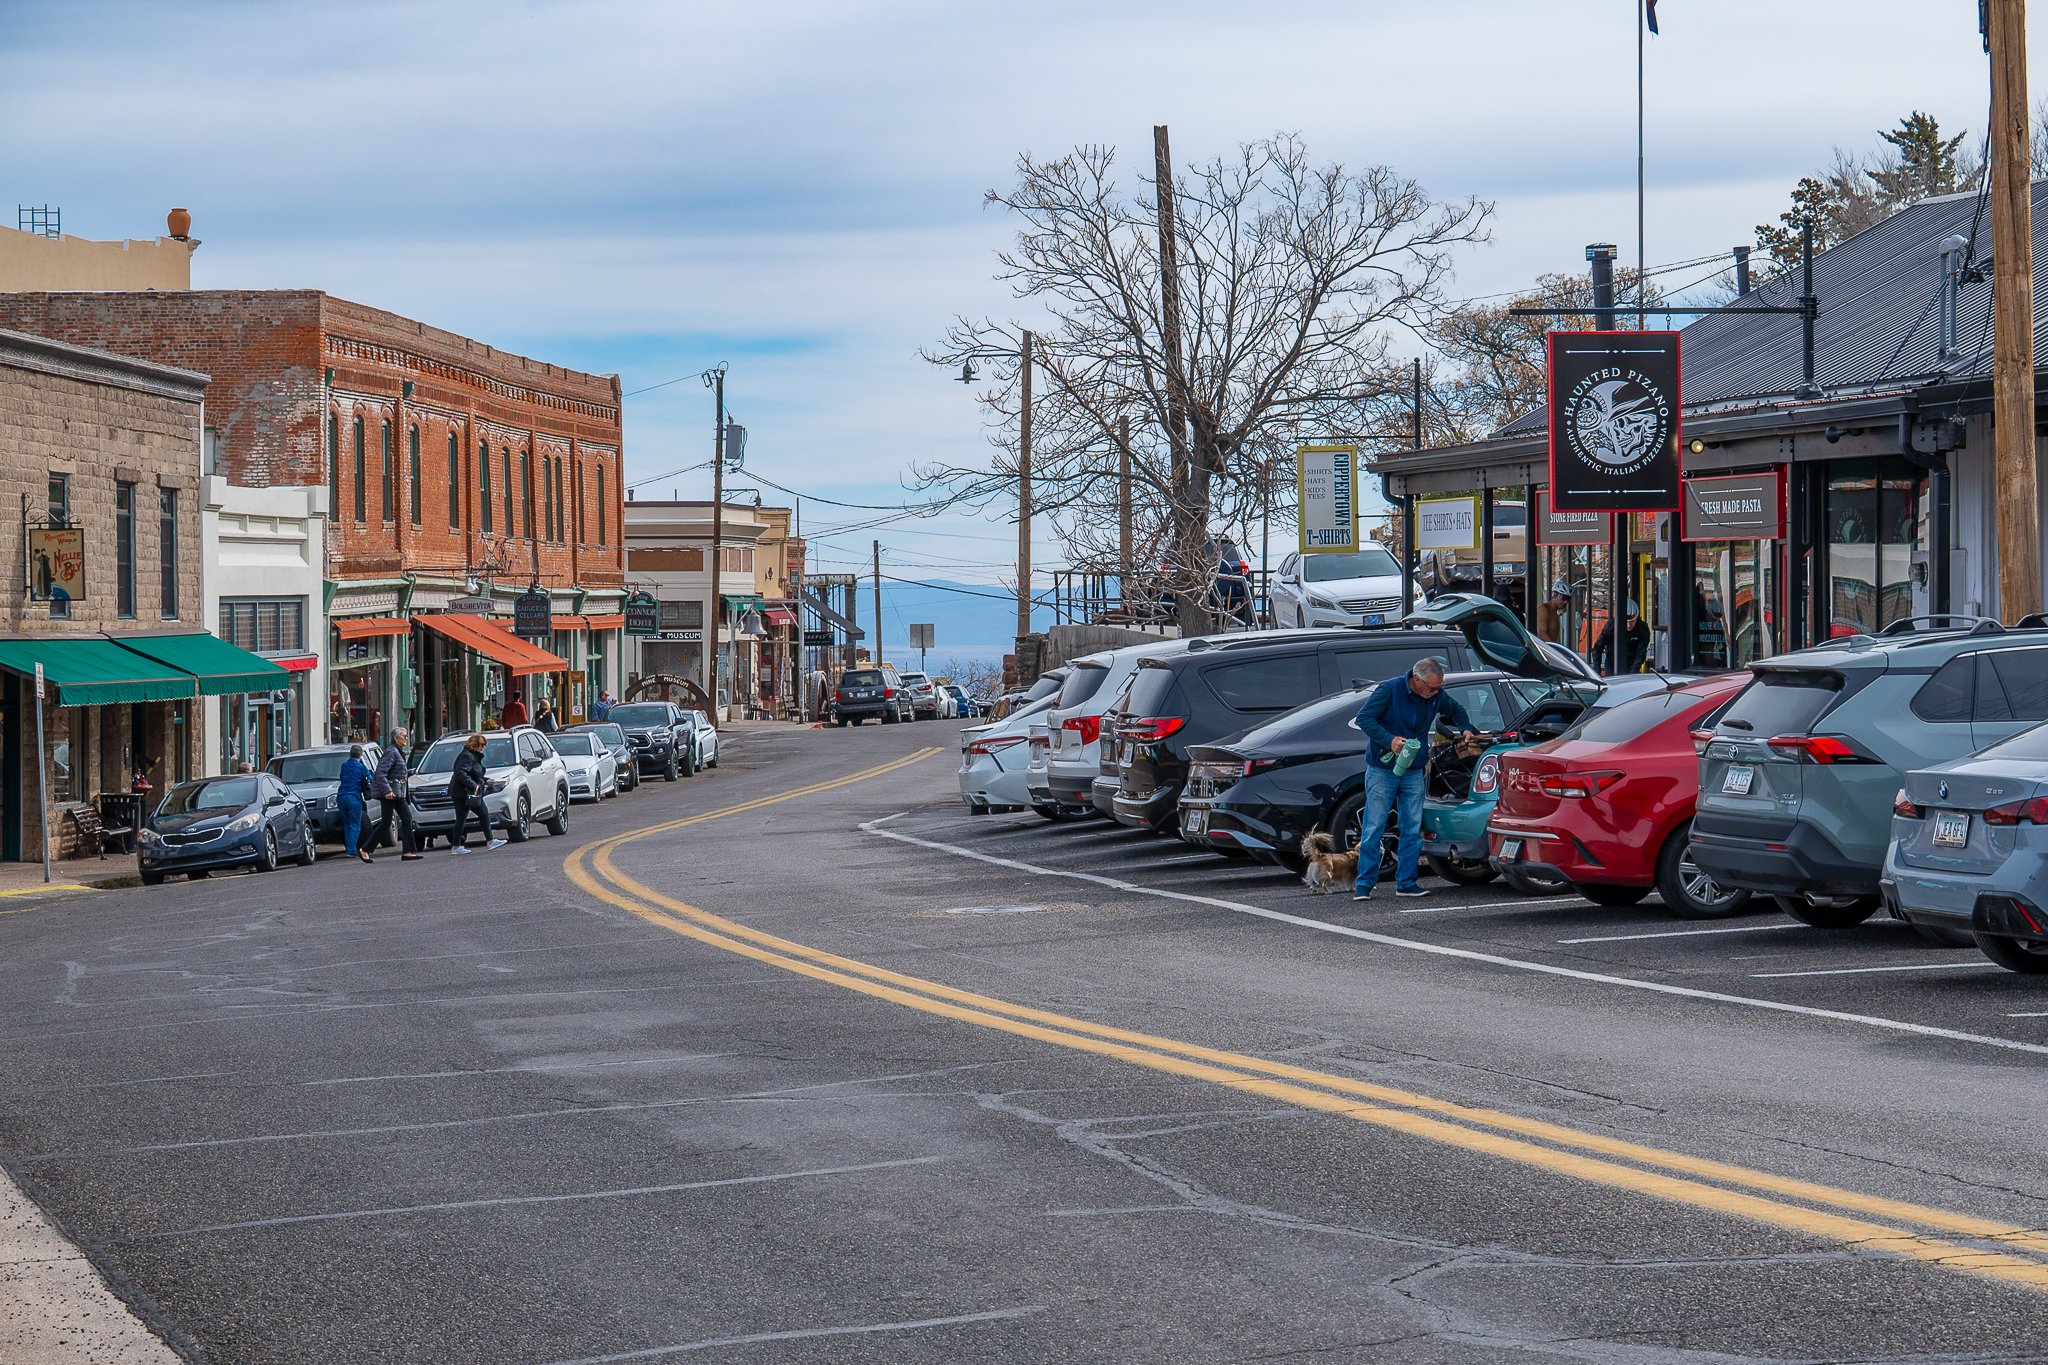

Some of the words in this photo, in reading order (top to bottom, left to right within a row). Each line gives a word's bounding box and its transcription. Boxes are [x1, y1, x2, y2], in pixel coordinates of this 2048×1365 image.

[1564, 367, 1620, 417] HAUNTED
[1627, 369, 1669, 417] PIZANO
[1566, 427, 1602, 472] AUTHENTIC
[1604, 463, 1641, 476] ITALIAN
[1642, 427, 1667, 466] PIZZERIA
[1333, 453, 1350, 526] COPPERTOWN
[1700, 501, 1721, 515] FRESH
[1721, 499, 1741, 514] MADE
[1741, 498, 1762, 513] PASTA
[1422, 514, 1433, 532] TEE
[1433, 512, 1453, 531] SHIRTS
[1456, 511, 1472, 530] HATS
[1550, 512, 1566, 523] STONE
[1566, 512, 1582, 523] FIRED
[1582, 511, 1599, 522] PIZZA
[1307, 529, 1351, 545] T-SHIRTS
[53, 548, 82, 576] NELLIE
[626, 607, 657, 617] CONNOR
[663, 676, 689, 688] MUSEUM
